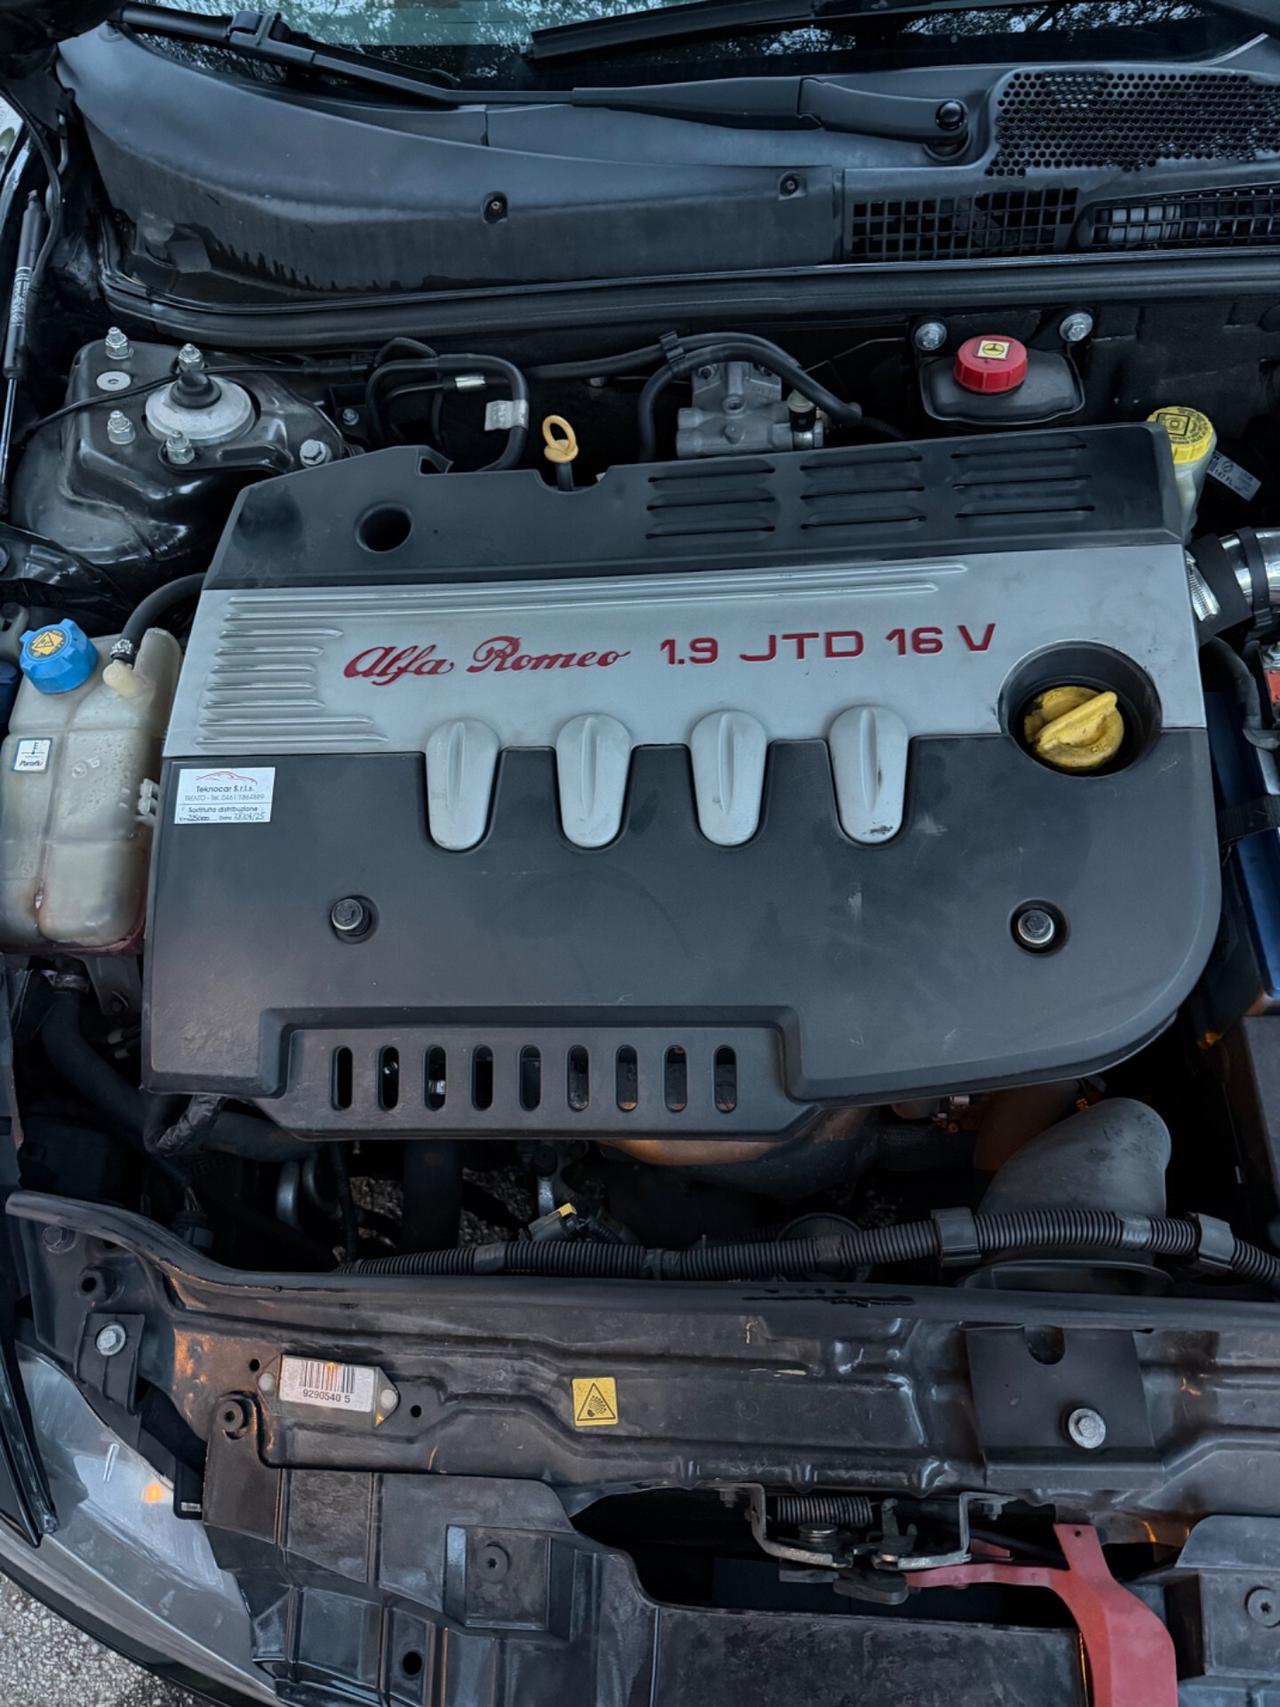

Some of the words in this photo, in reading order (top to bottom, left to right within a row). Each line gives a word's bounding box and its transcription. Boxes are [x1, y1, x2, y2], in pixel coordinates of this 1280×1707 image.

[343, 644, 455, 687] Alfa
[465, 636, 631, 673] Romeo
[660, 637, 719, 665] 1.9
[739, 630, 864, 662] JTD
[885, 626, 944, 656] 16
[957, 622, 996, 652] V
[196, 785, 232, 793] Teknocar
